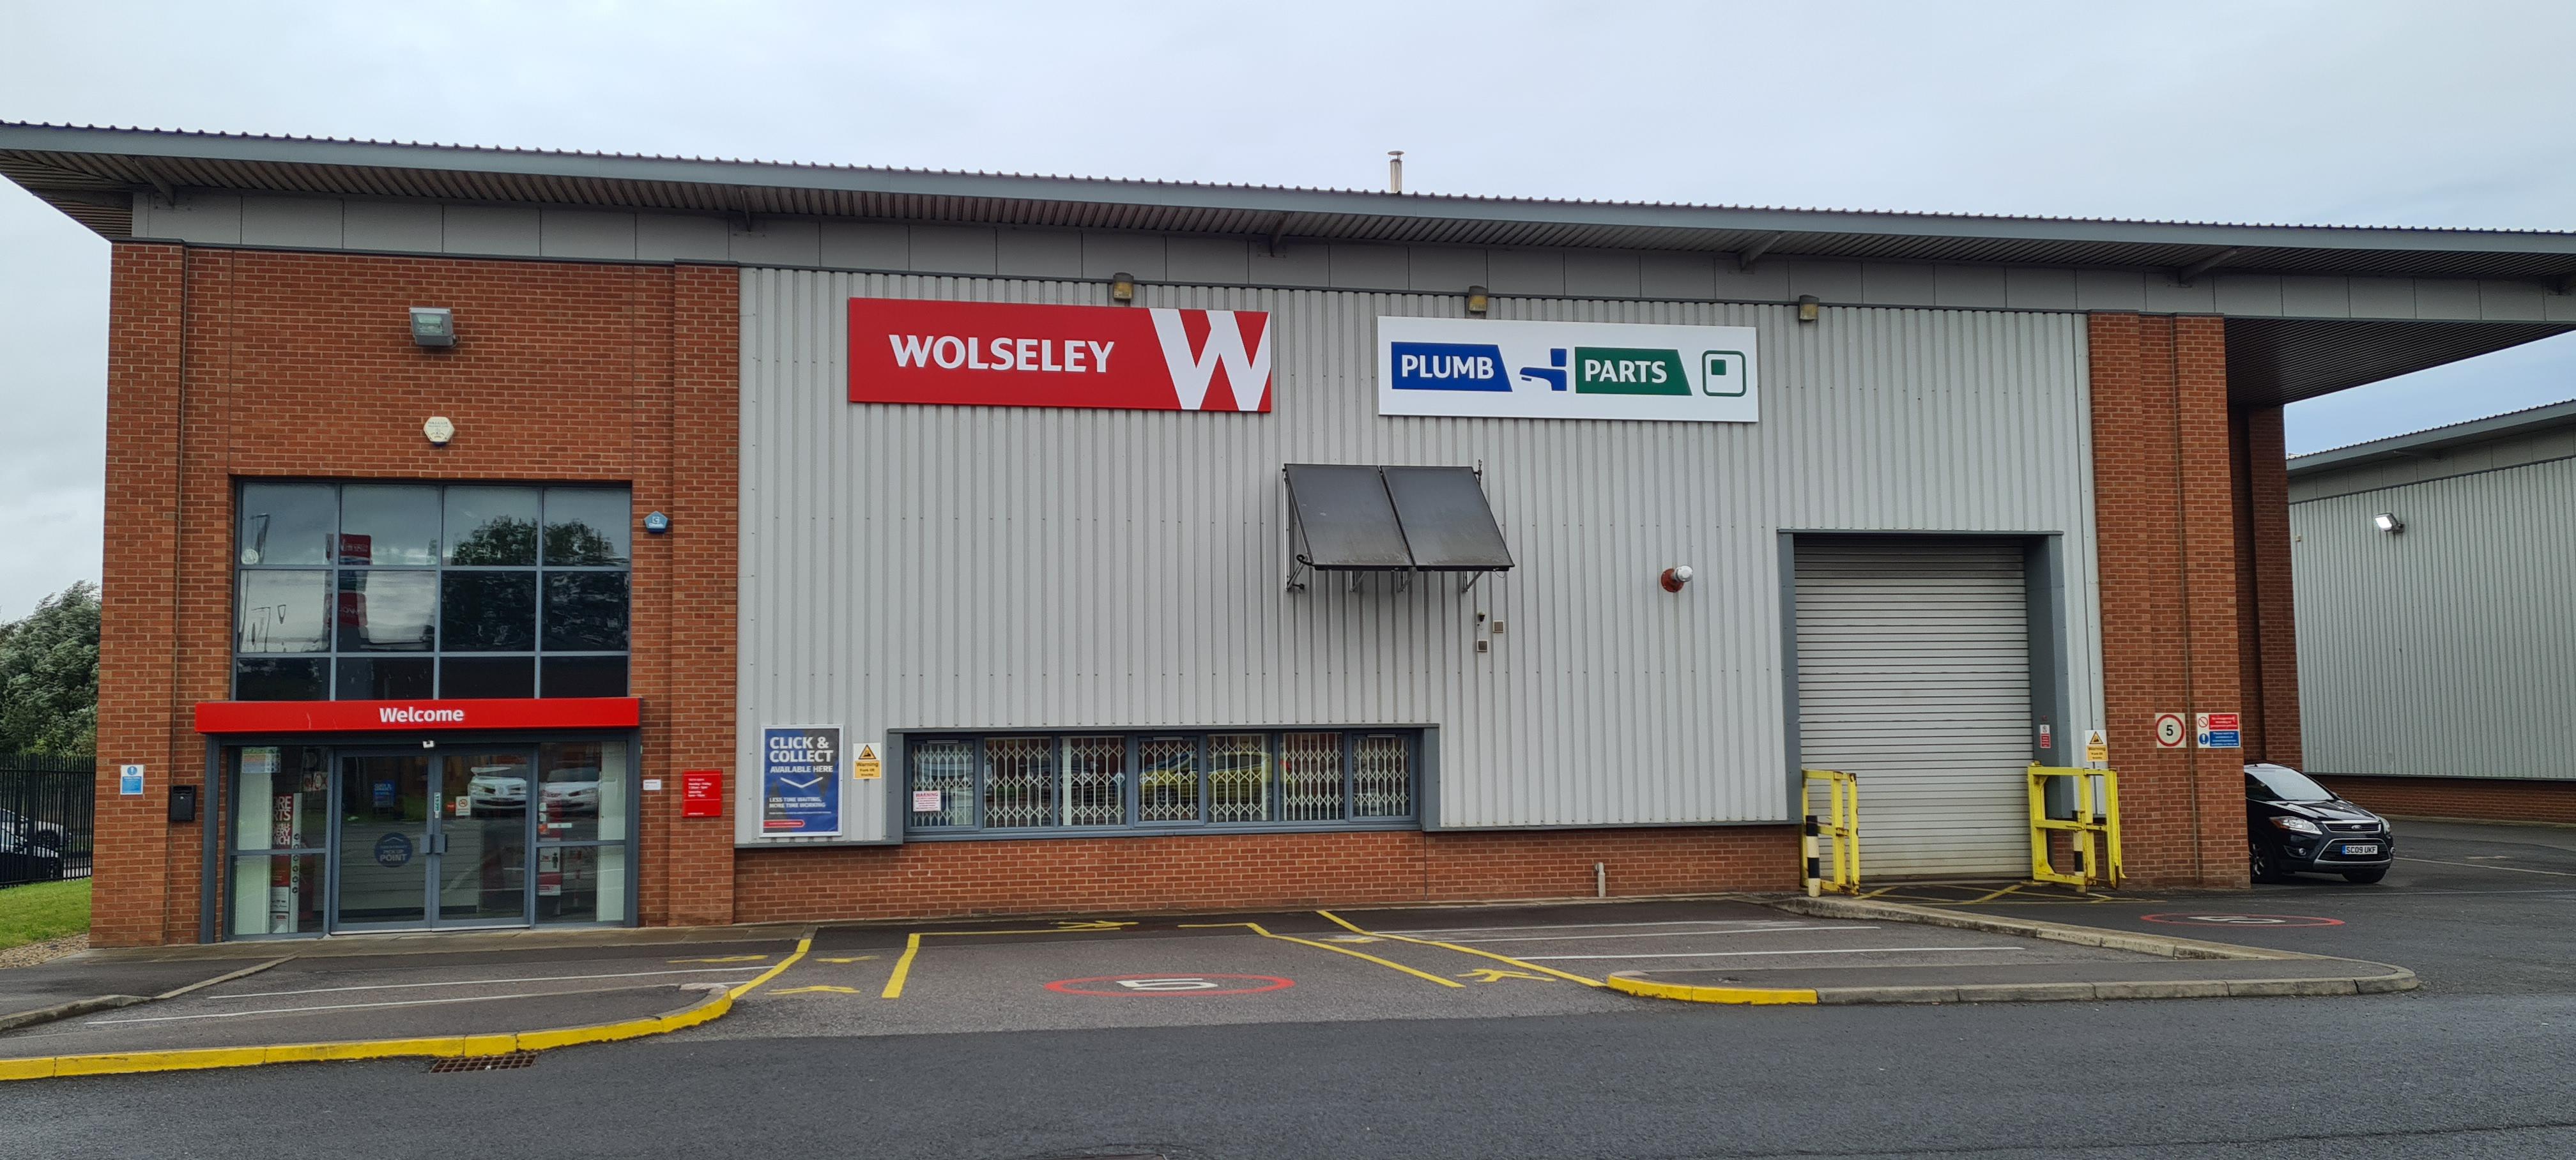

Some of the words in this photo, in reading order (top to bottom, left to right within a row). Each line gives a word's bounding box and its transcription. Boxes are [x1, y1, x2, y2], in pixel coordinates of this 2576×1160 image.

[889, 334, 1114, 373] WOLSELEY
[1401, 355, 1494, 379] PLUMB
[1584, 360, 1667, 383] PARTS
[379, 706, 464, 723] Welcome
[2166, 724, 2174, 736] 5
[770, 736, 814, 749] CLICK
[816, 736, 829, 749] &
[769, 750, 834, 763] COLLECT
[1116, 978, 1218, 991] 5
